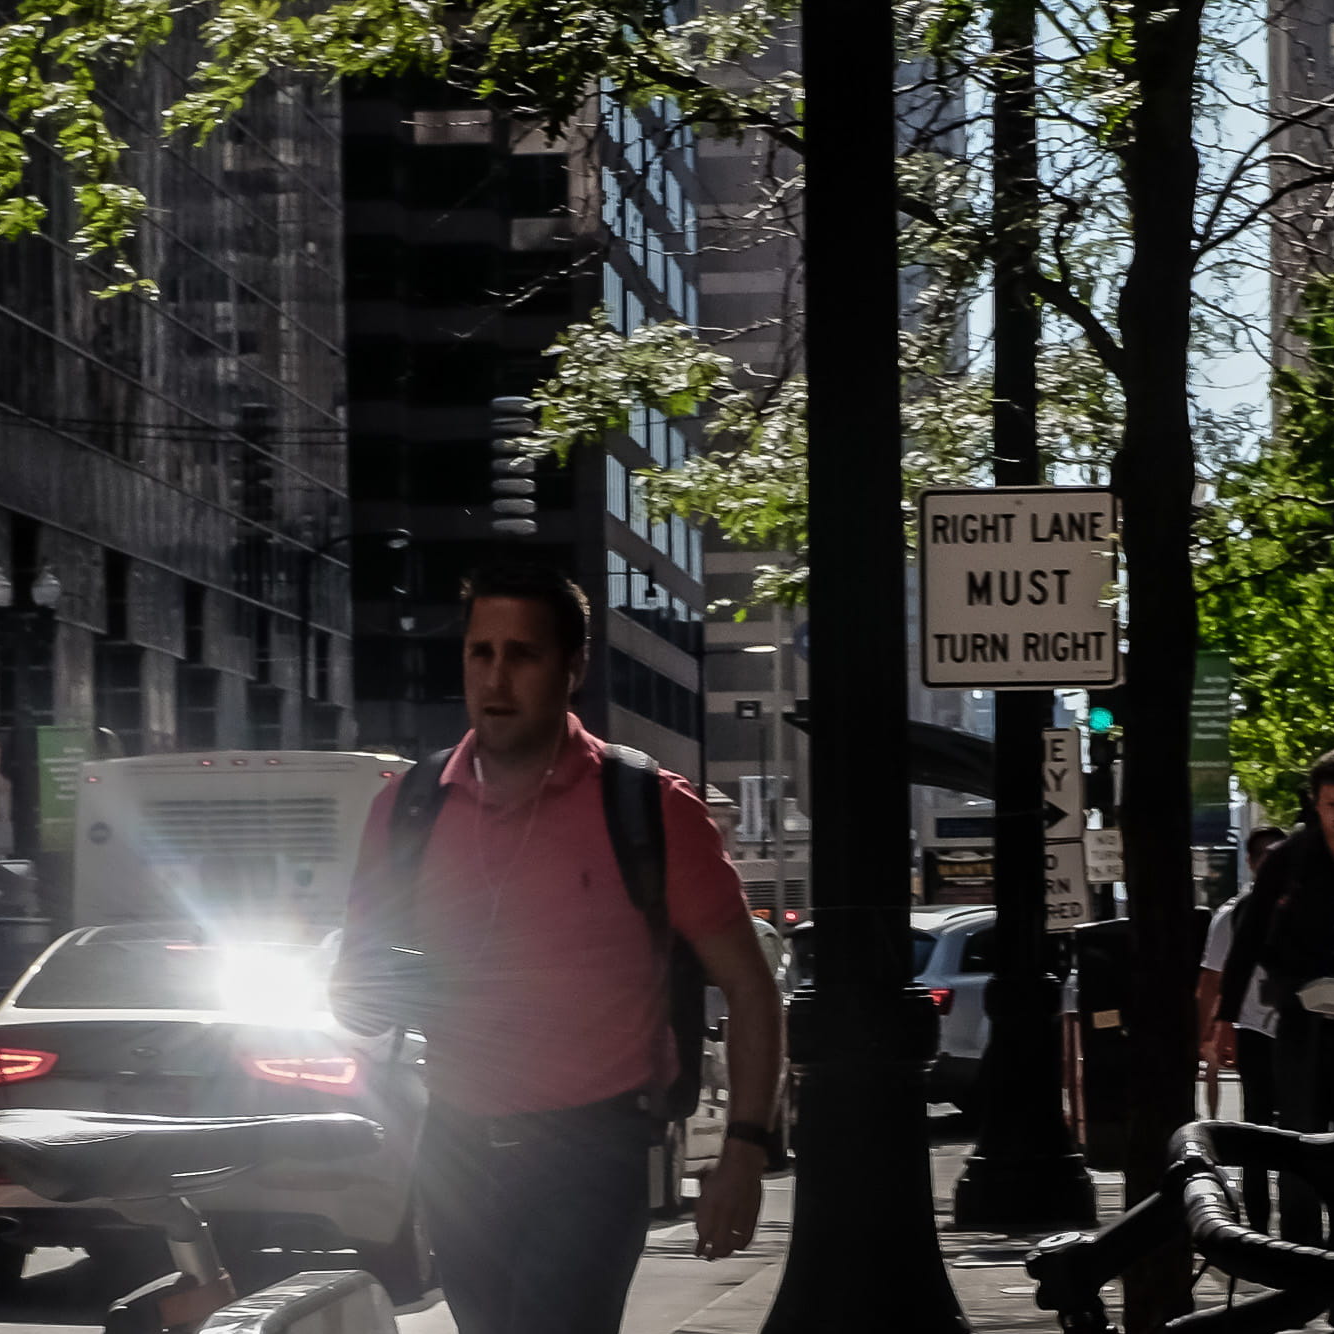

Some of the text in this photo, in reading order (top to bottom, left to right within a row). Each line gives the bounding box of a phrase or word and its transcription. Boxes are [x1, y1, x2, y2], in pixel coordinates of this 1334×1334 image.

[932, 512, 1105, 543] RIGHT LANE
[967, 569, 1071, 605] MUST
[933, 632, 1107, 663] TURN RIGHT
